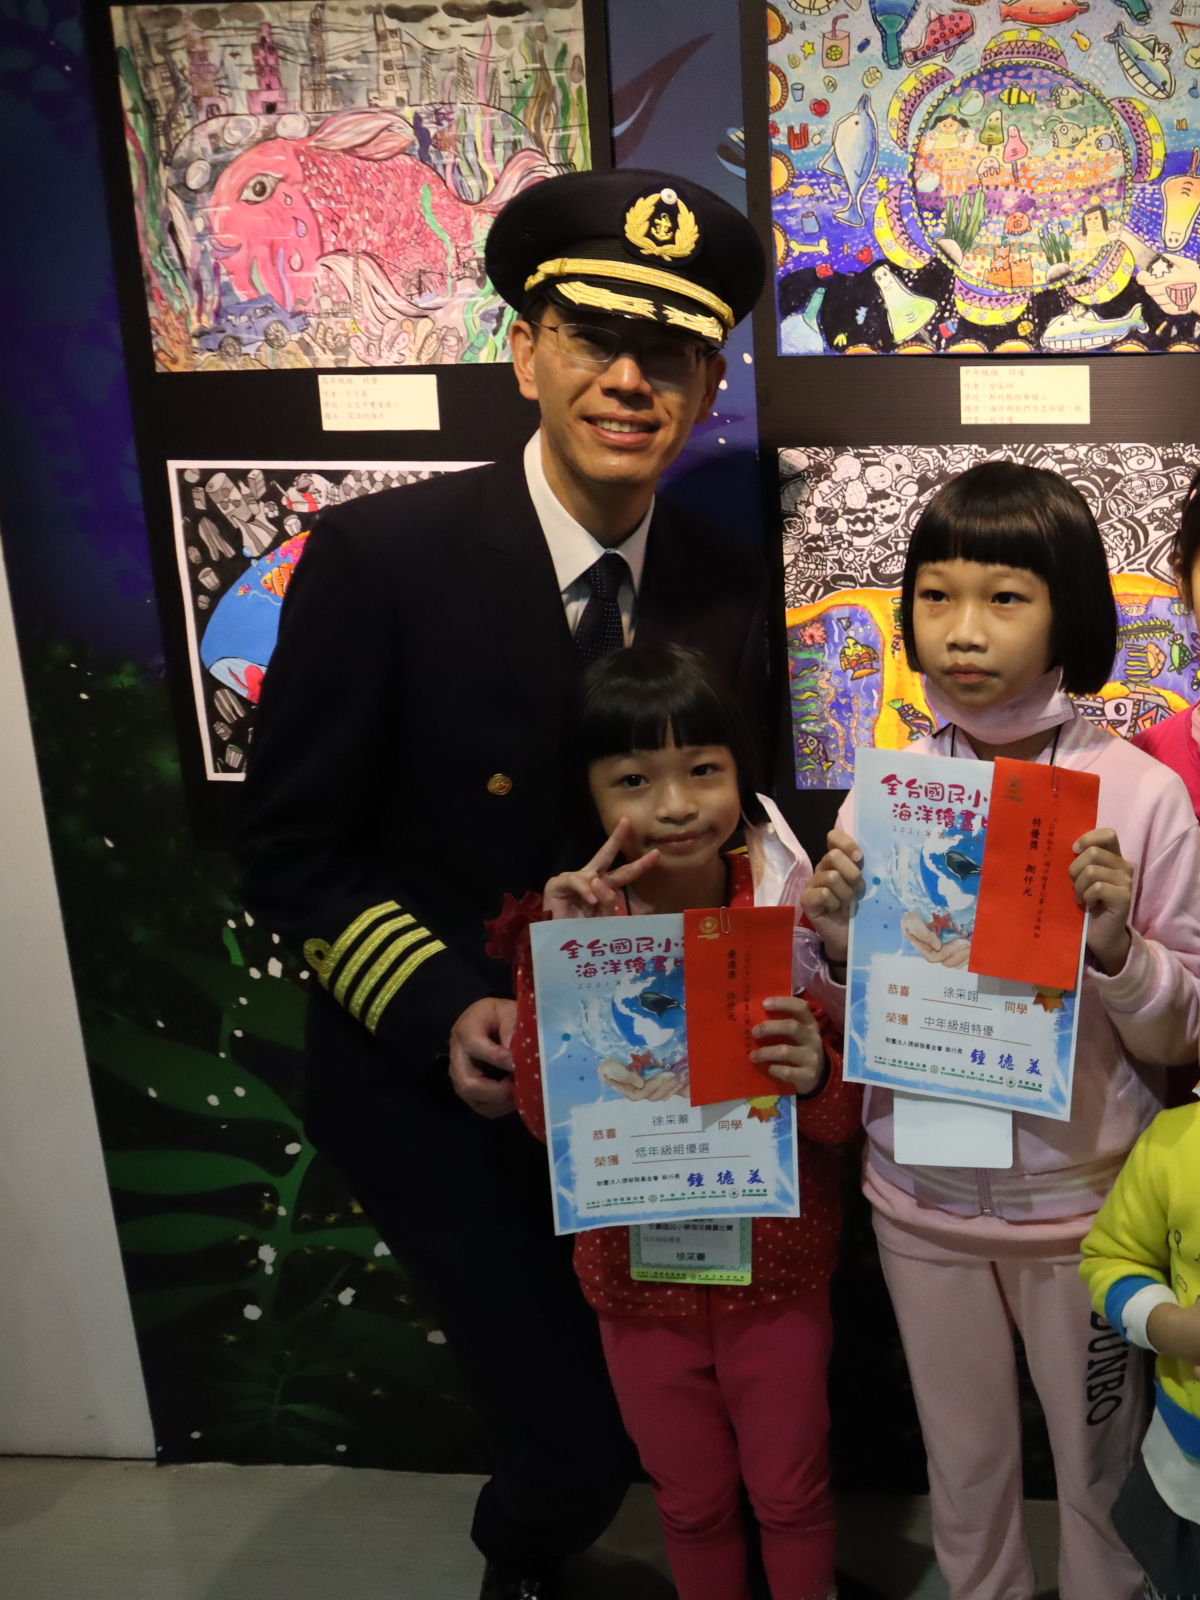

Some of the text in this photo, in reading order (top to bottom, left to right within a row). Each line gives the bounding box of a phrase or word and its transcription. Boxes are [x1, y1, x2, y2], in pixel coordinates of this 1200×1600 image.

[1022, 817, 1042, 897] 特優獎 捌仟元
[560, 936, 684, 960] 全台國民小
[887, 984, 1028, 1016] 恭喜 徐采翊 同學
[886, 1012, 994, 1038] 榮獲 中年級組特優
[592, 1128, 618, 1142] 恭喜
[718, 1119, 743, 1132] 同學
[594, 1142, 710, 1168] 榮獲 低年級組優選
